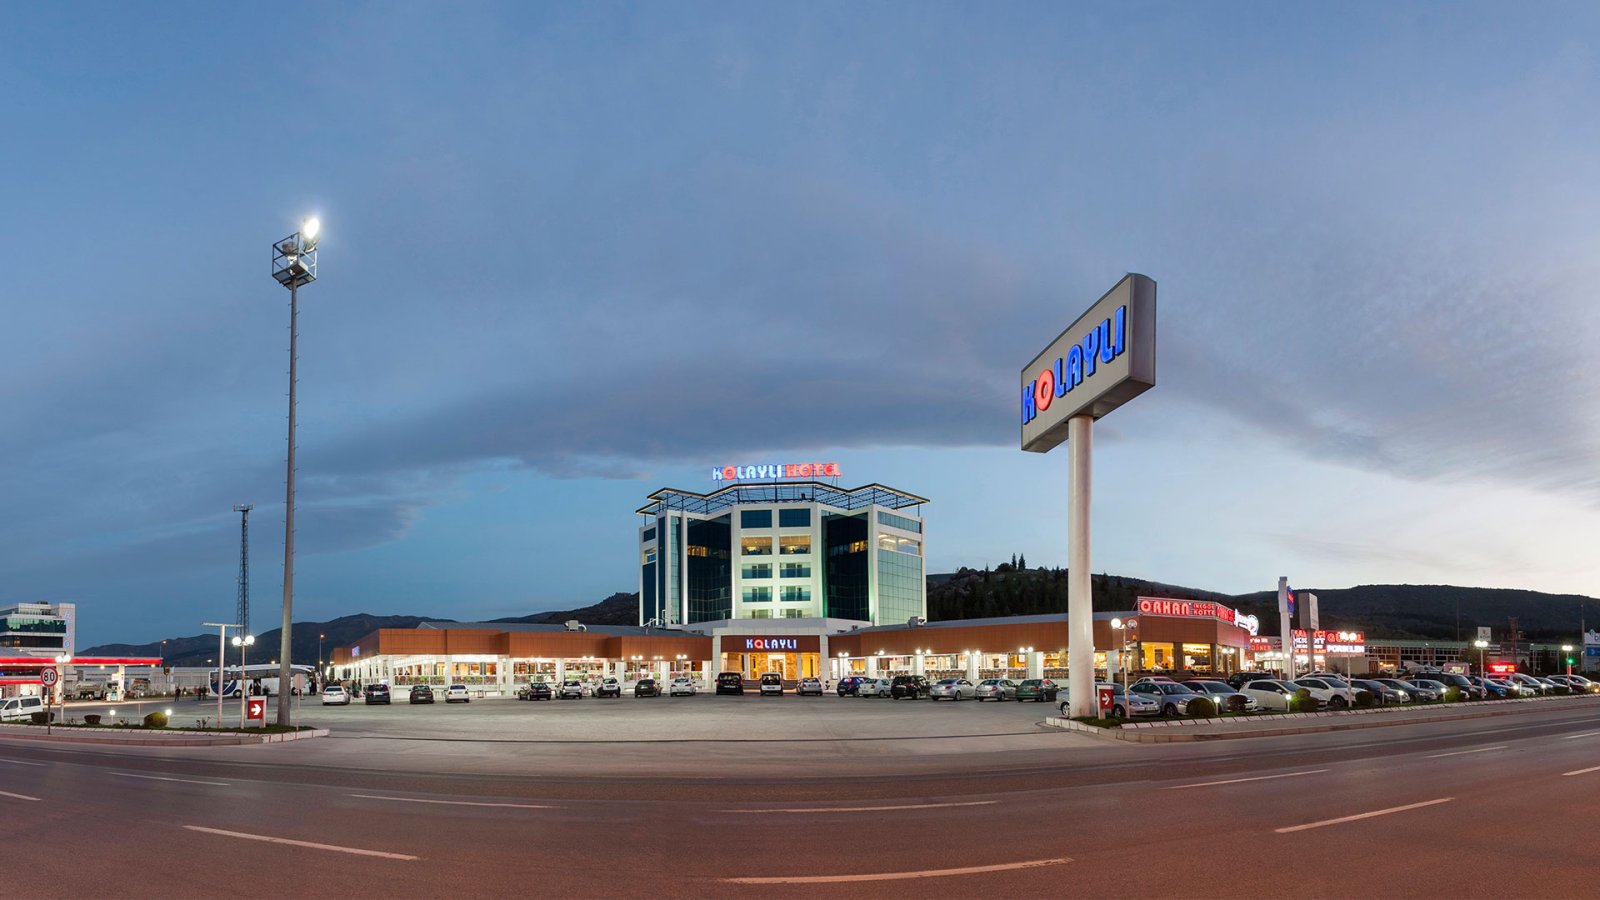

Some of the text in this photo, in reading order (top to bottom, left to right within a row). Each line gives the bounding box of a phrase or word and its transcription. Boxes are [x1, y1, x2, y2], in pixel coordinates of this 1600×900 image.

[1023, 305, 1126, 425] KOLAYLI
[712, 463, 841, 480] KOLAYLI HOTEL
[1140, 600, 1190, 615] ORHAN
[44, 672, 55, 682] 80
